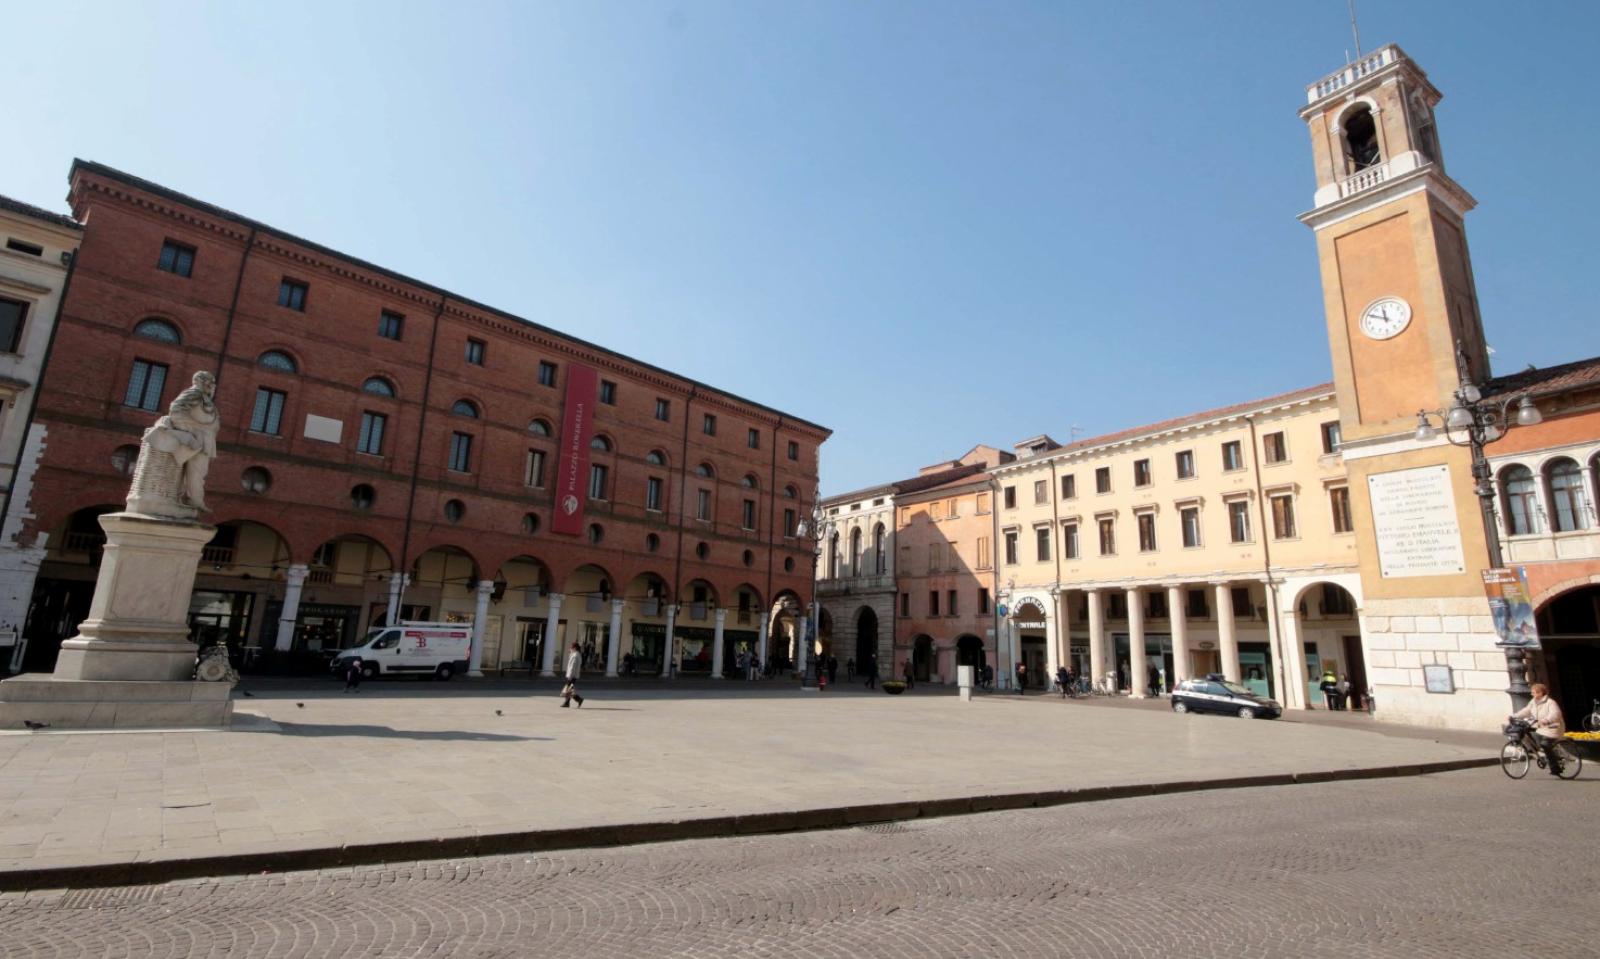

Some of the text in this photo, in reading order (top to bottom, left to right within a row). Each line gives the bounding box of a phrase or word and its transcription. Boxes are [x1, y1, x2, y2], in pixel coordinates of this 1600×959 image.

[568, 403, 584, 490] PALAZZO ROVERELLA
[1014, 597, 1045, 614] FARMACIA
